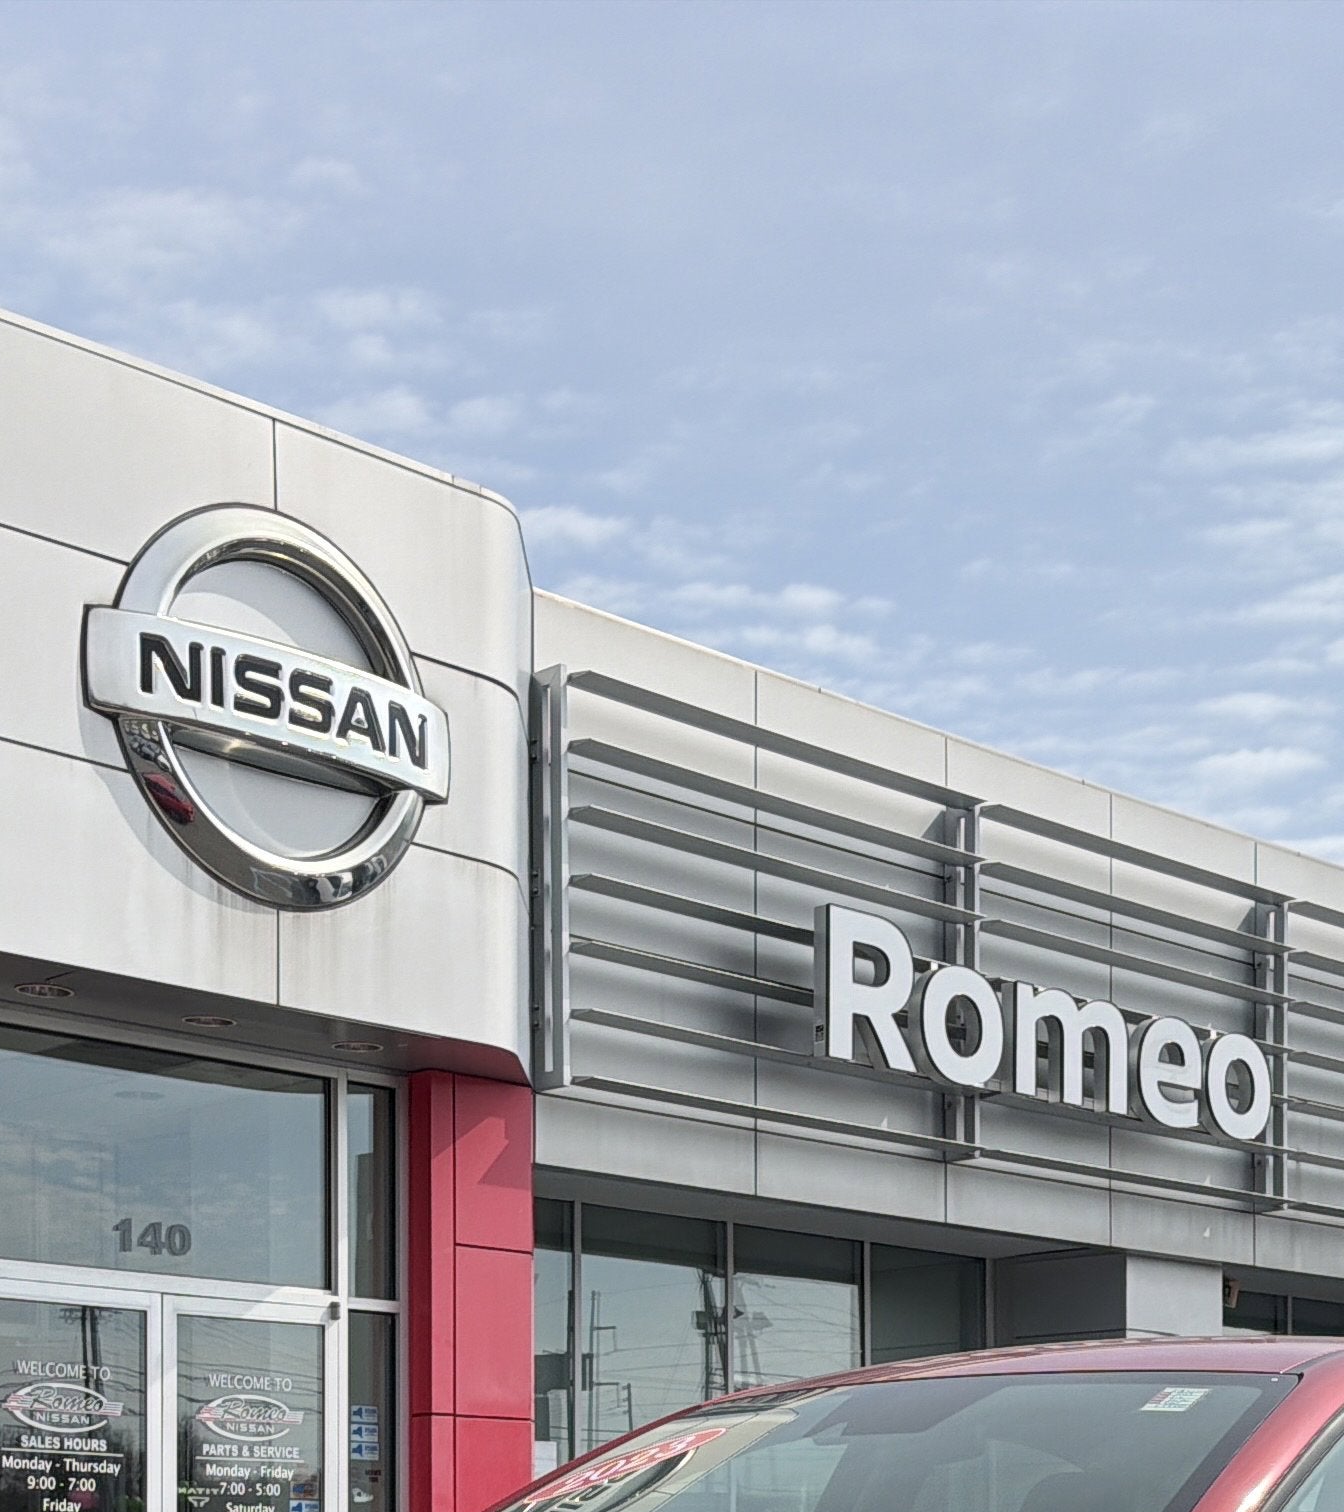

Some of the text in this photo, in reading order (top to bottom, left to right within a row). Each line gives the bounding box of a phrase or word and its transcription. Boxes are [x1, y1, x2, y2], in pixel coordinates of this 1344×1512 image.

[138, 631, 430, 773] NISSAN
[815, 903, 1271, 1140] Romeo
[112, 1218, 191, 1256] 140
[17, 1359, 111, 1381] WELCOME TO
[209, 1373, 292, 1392] WELCOME TO
[29, 1385, 104, 1413] Romeo
[220, 1397, 287, 1421] Romeo
[35, 1412, 90, 1424] NISSAN
[226, 1422, 275, 1433] NISSAN
[20, 1434, 107, 1451] SALES HOURS
[202, 1443, 300, 1459] PARTS & SERVICE
[2, 1455, 52, 1472] Monday
[63, 1458, 121, 1476] Thursday
[206, 1463, 251, 1479] Monday
[260, 1465, 294, 1481] Friday
[553, 1435, 697, 1496] 2023
[27, 1476, 56, 1490] 9:00
[68, 1477, 96, 1492] 7:00
[220, 1482, 245, 1495] 7:00
[255, 1483, 281, 1496] 5:00
